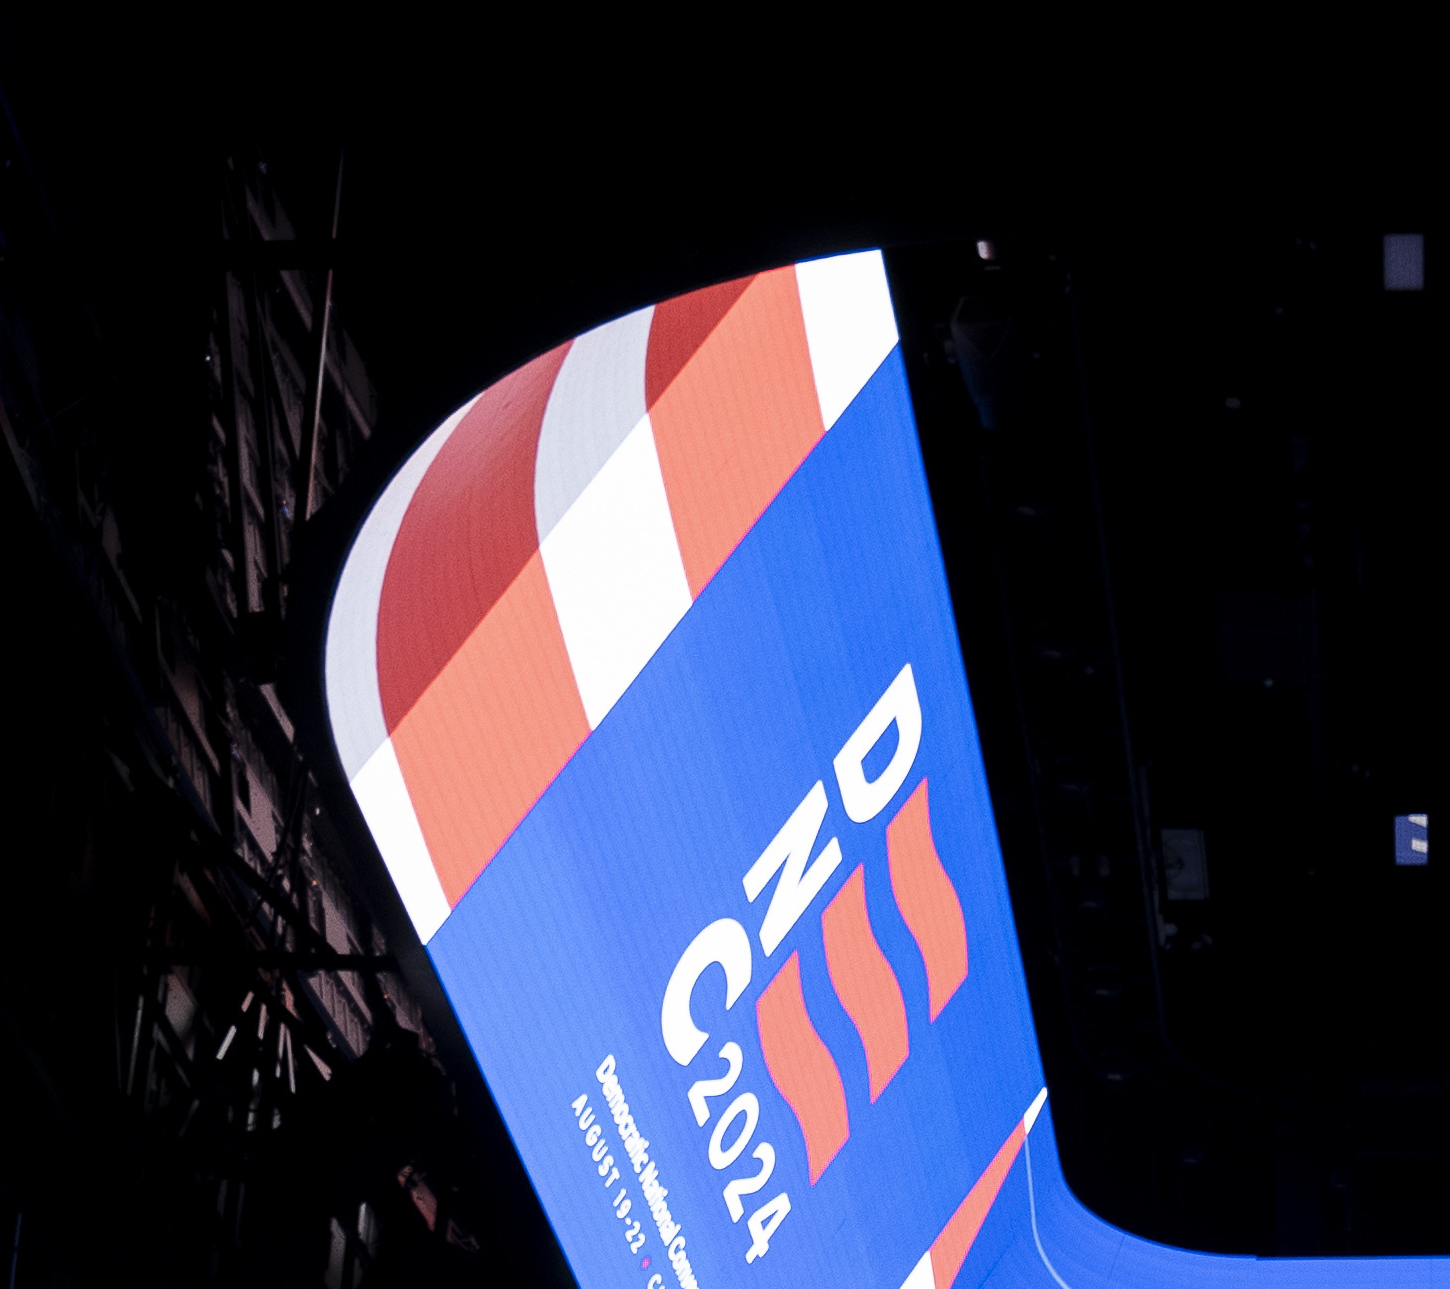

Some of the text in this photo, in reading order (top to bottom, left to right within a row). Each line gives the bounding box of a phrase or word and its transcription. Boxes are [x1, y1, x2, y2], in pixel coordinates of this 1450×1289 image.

[660, 662, 923, 1067] DNC
[571, 1093, 621, 1188] AUGUST
[613, 1188, 646, 1254] 19-22
[596, 1054, 650, 1174] Democratic
[639, 1160, 681, 1248] National
[687, 1040, 793, 1265] 2024
